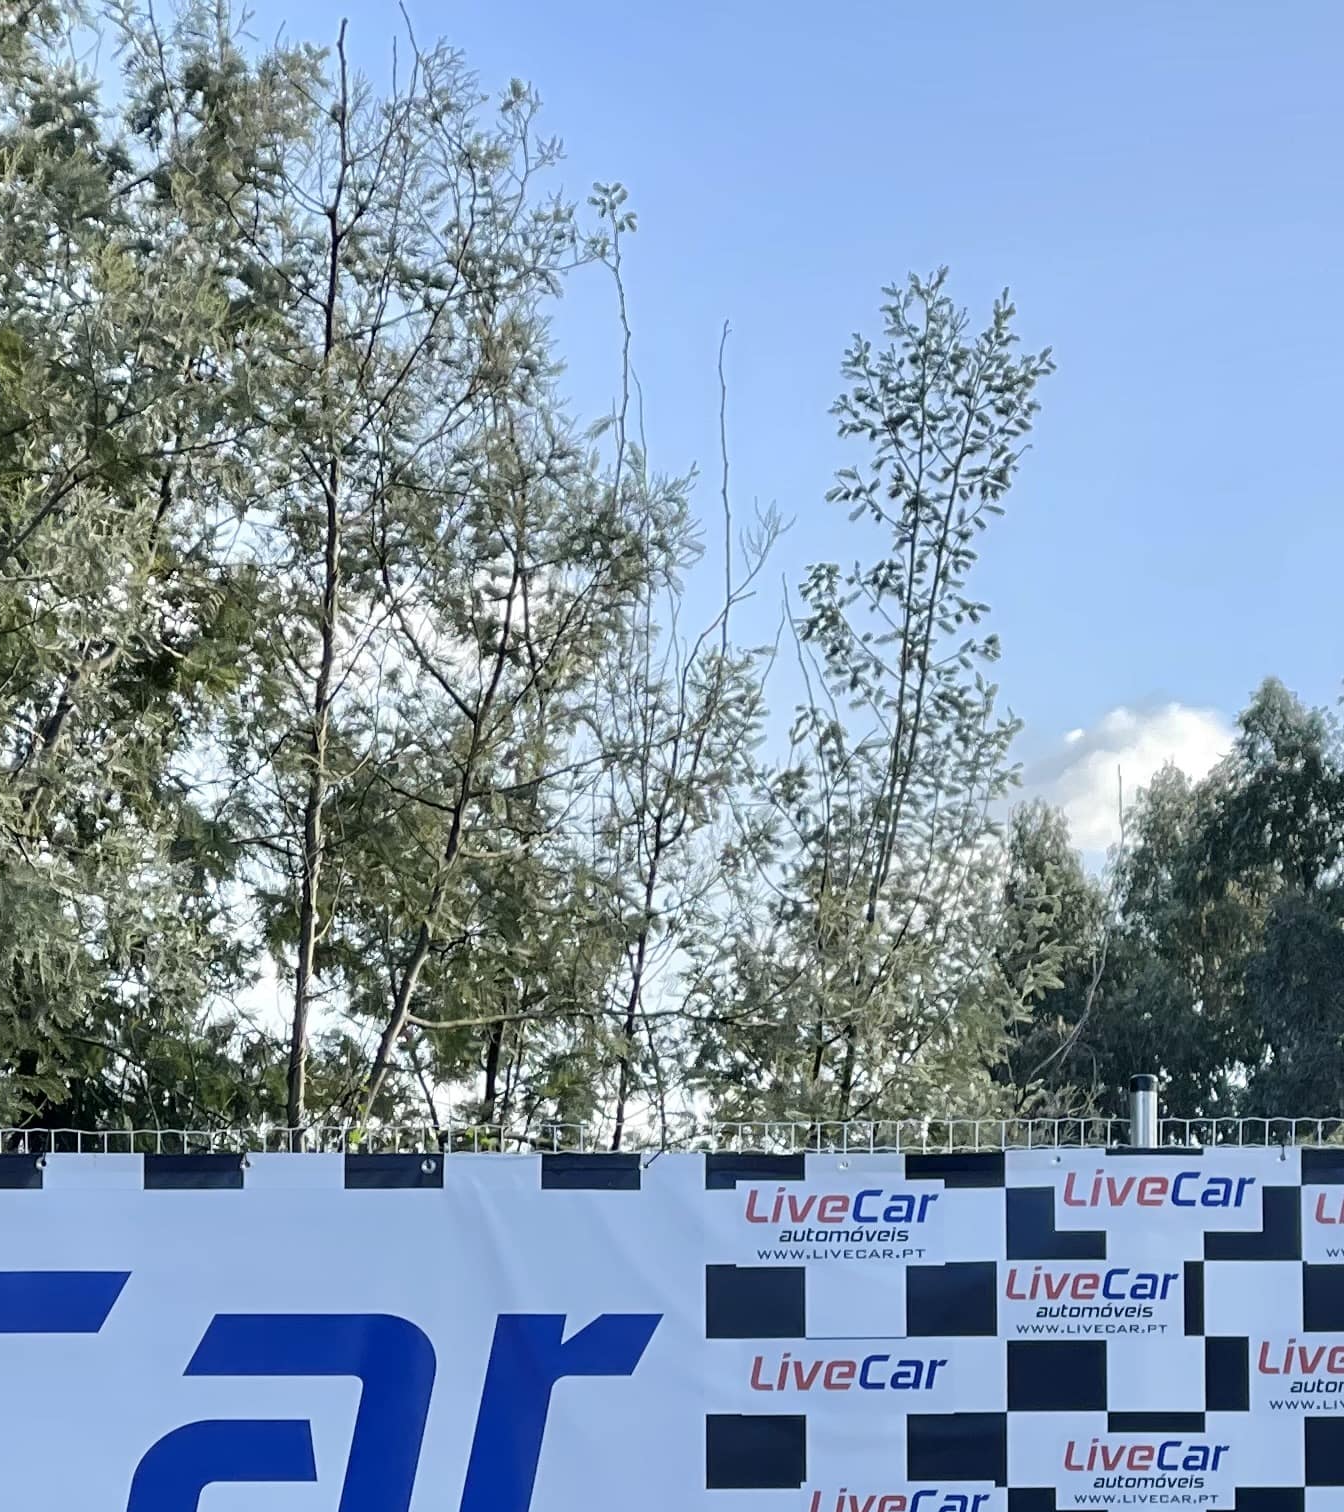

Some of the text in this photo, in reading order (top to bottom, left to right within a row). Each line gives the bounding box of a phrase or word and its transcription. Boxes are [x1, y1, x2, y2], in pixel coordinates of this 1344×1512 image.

[1064, 1169, 1254, 1207] LiveCar
[745, 1187, 939, 1224] LiveCar
[779, 1227, 909, 1243] automóveis
[757, 1249, 926, 1259] WWW.LIVECAR.PT
[1006, 1266, 1178, 1301] LiveCar
[1036, 1303, 1153, 1319] automóveis
[1017, 1325, 1167, 1333] WWW.LIVECAR.PT
[751, 1353, 947, 1391] LiveCar
[1064, 1438, 1229, 1472] LiveCar
[1094, 1474, 1204, 1489] automóveis
[1075, 1495, 1218, 1503] WWW.LIVECAR.PT
